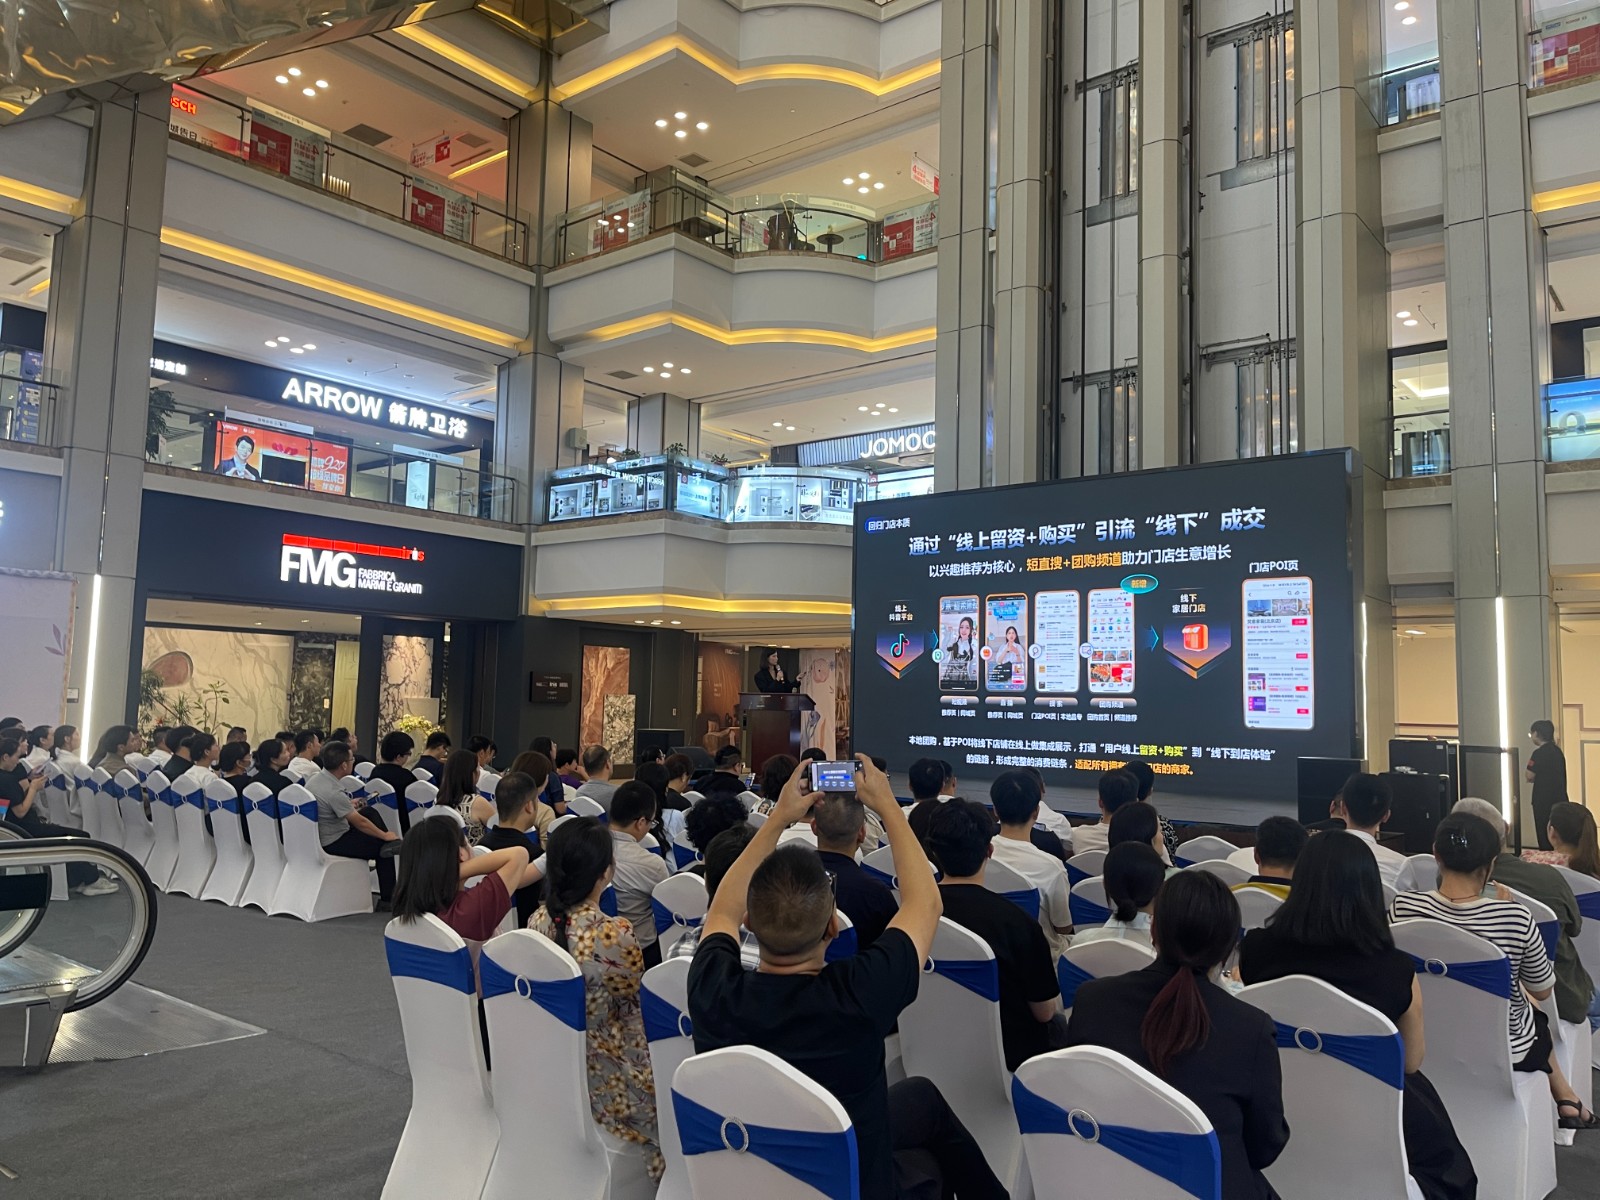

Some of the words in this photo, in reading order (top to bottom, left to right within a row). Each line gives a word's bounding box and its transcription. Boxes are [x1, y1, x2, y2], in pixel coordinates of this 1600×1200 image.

[170, 97, 197, 115] SCH
[281, 377, 383, 420] ARROW
[388, 400, 469, 440] 箭牌卫浴
[868, 518, 911, 532] 回归门店本质
[280, 545, 357, 589] FMG
[1249, 559, 1299, 574] 门店POI页
[358, 567, 396, 582] FABBRICA
[358, 578, 386, 591] MARMI
[386, 581, 393, 592] E
[1180, 593, 1198, 603] 线下
[894, 604, 908, 613] 线上
[1172, 603, 1206, 614] 家居门店
[889, 612, 914, 622] 抖音平台
